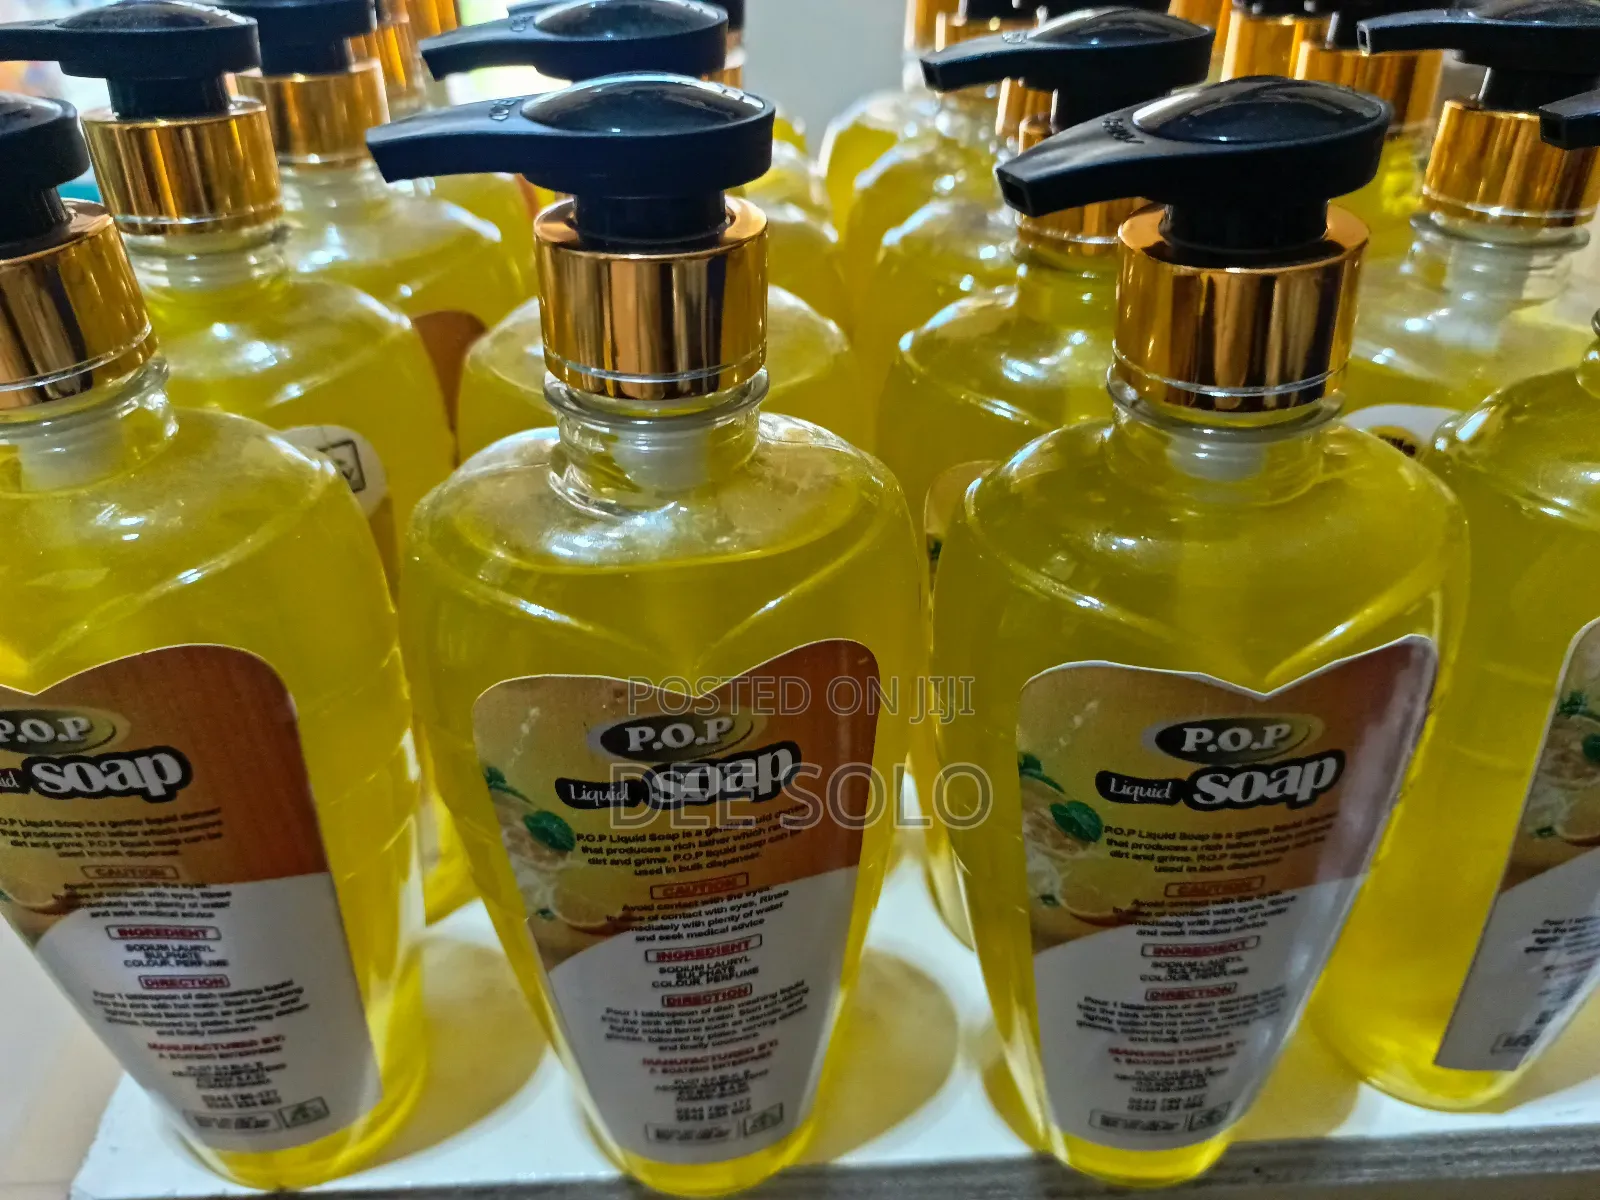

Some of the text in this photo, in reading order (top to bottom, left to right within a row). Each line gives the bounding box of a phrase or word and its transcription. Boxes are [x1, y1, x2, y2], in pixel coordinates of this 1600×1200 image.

[625, 717, 734, 752] P.O.P
[1181, 722, 1292, 752] P.O.P
[31, 752, 183, 797] soap
[569, 749, 792, 806] Liquid soap
[1110, 756, 1337, 805] Liquid soap
[609, 833, 647, 845] Liquid
[656, 940, 751, 963] INGREDIENT
